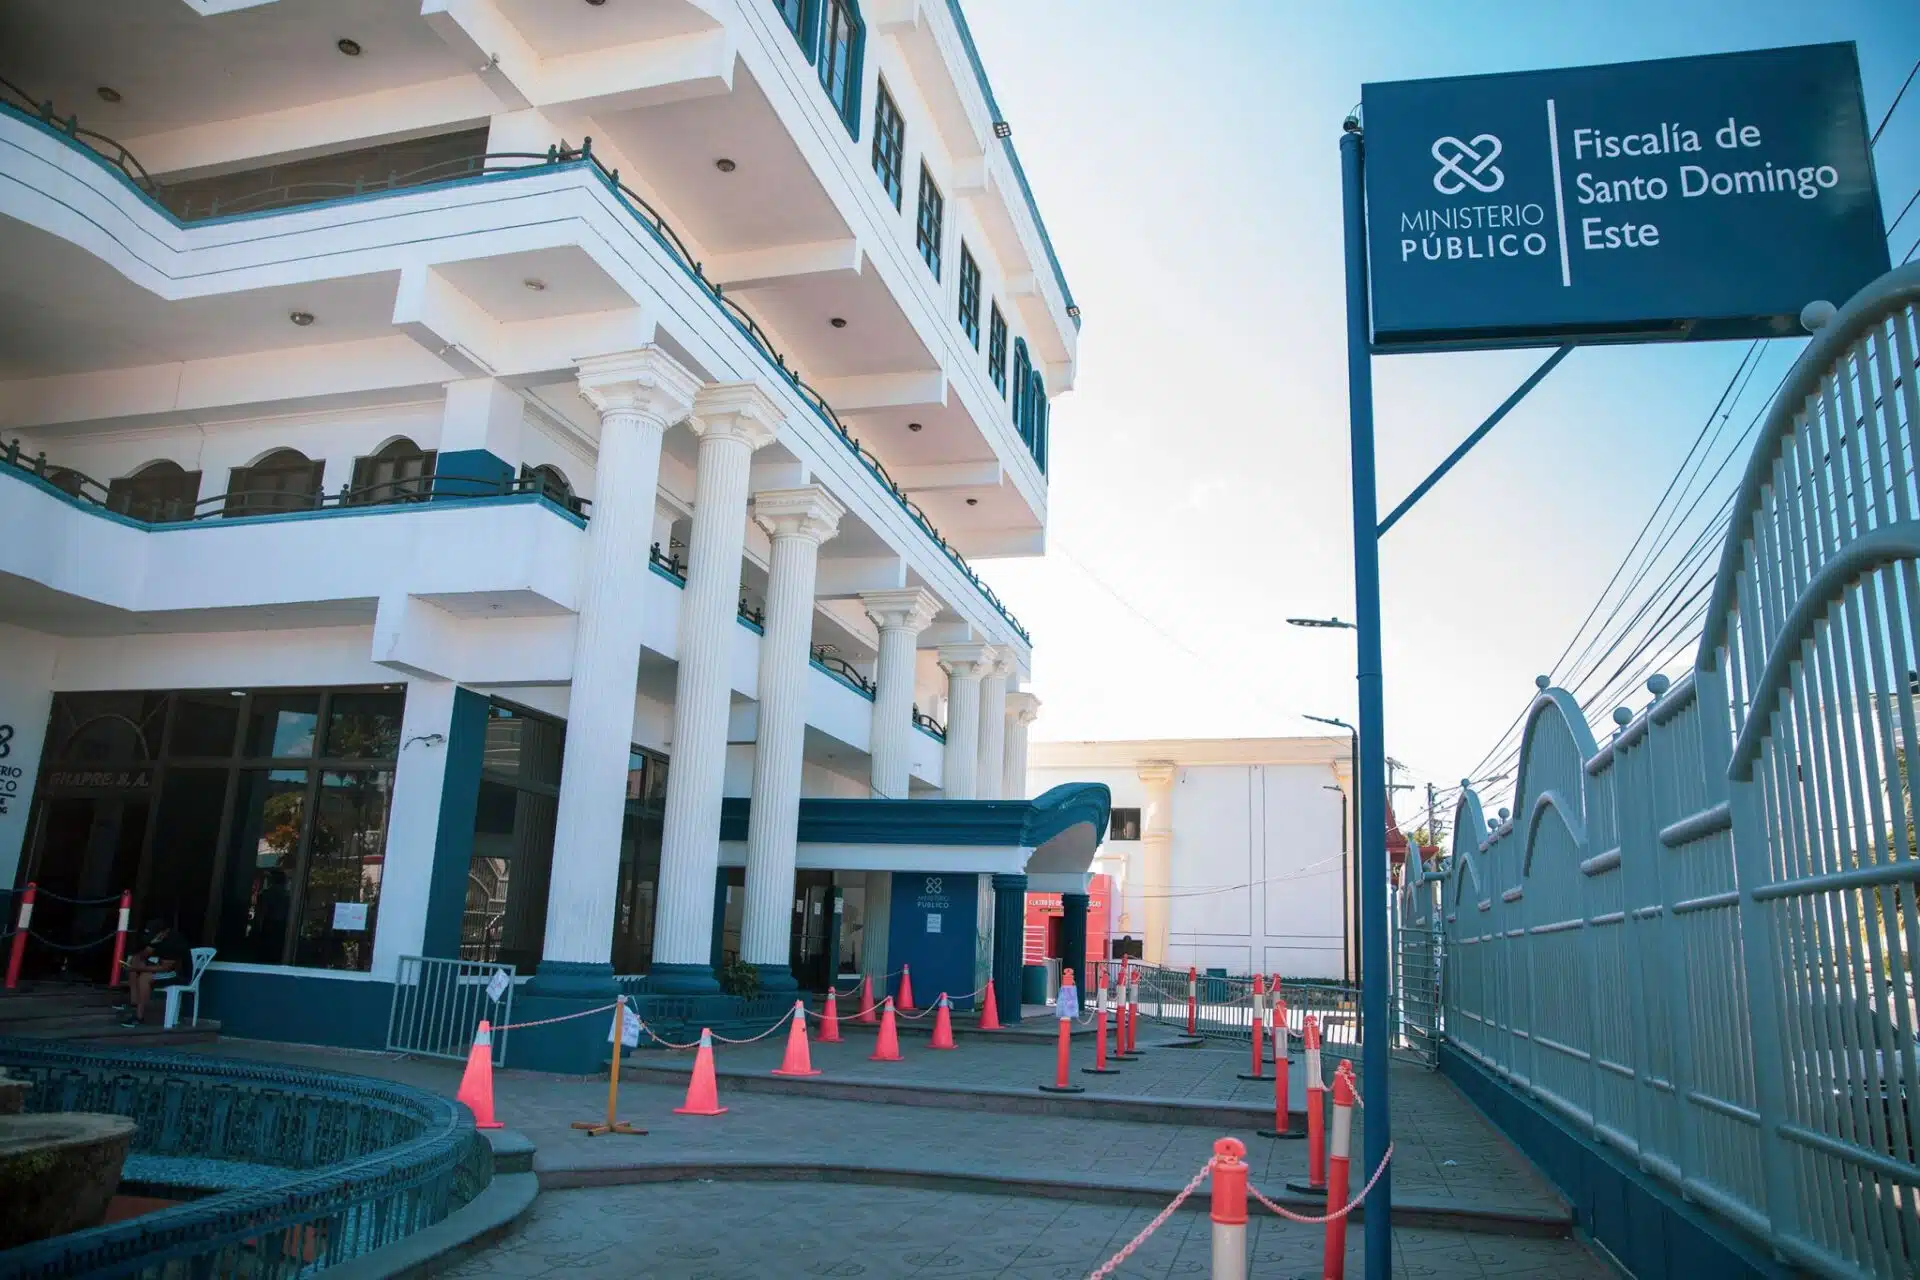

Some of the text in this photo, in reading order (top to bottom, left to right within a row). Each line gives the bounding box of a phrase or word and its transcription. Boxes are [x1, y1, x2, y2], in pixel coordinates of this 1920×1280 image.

[1573, 117, 1761, 160] Fiscalía de
[1576, 161, 1838, 205] Santo Domingo
[1401, 203, 1544, 233] MINISTERIO
[1582, 216, 1660, 251] Este
[1401, 231, 1547, 262] PÚBLICO
